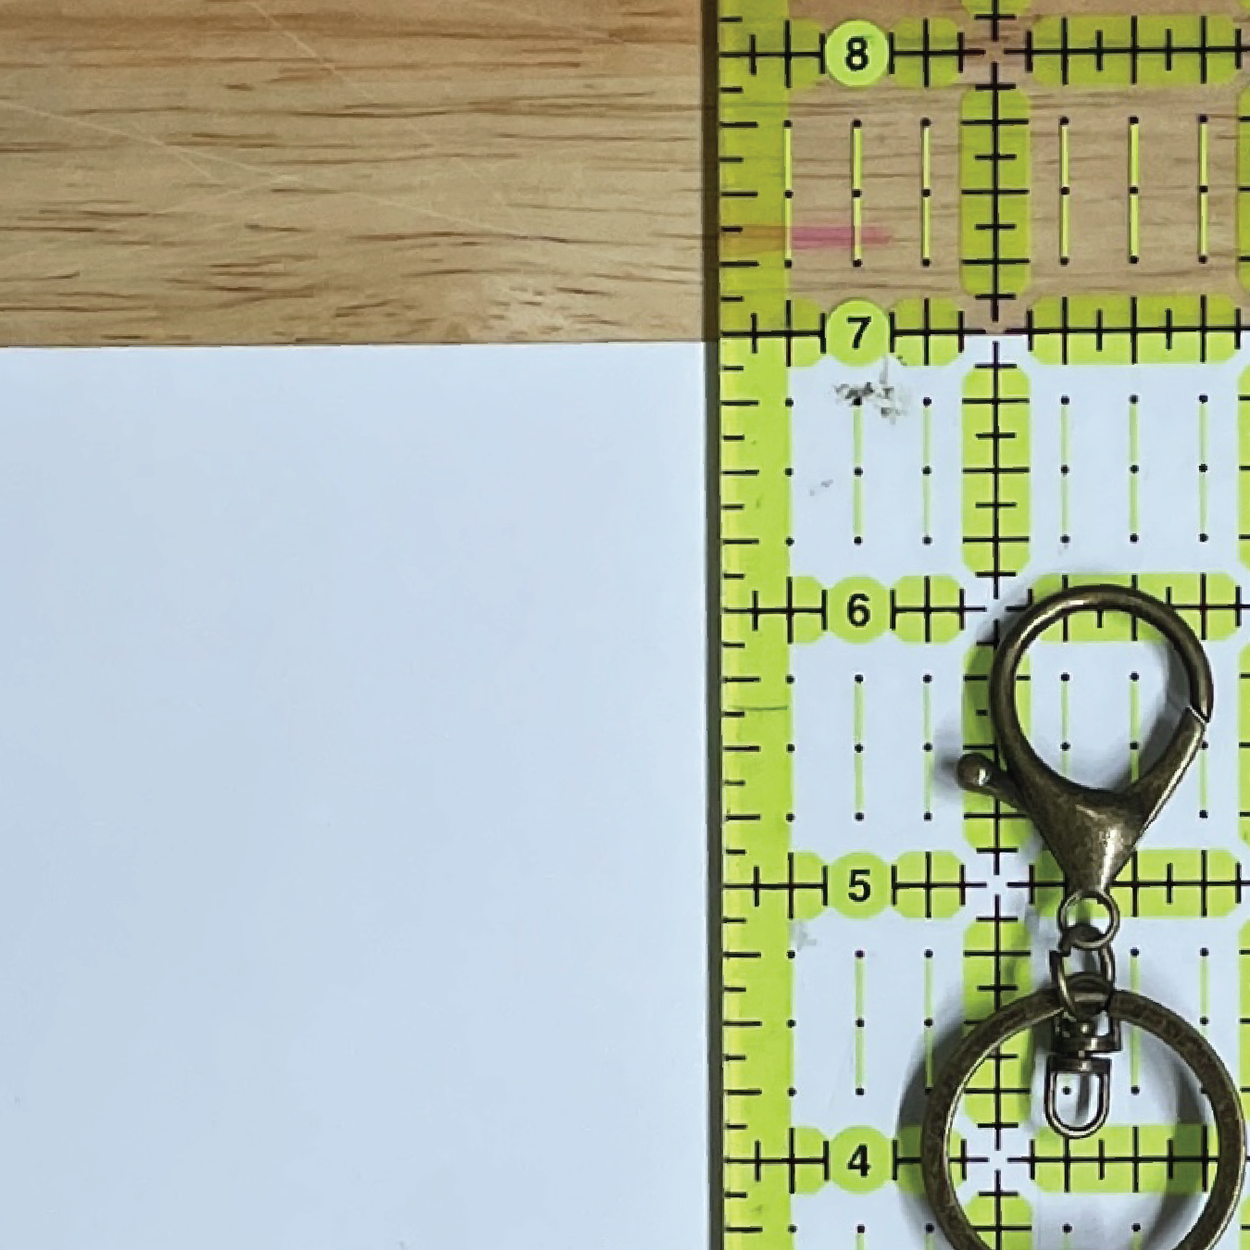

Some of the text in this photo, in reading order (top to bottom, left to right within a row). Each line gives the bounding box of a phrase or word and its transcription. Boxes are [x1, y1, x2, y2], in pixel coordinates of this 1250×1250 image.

[845, 35, 869, 72] 8
[847, 315, 872, 349] 7
[846, 593, 871, 628] 6
[847, 869, 871, 903] 5
[847, 1144, 871, 1177] 4
